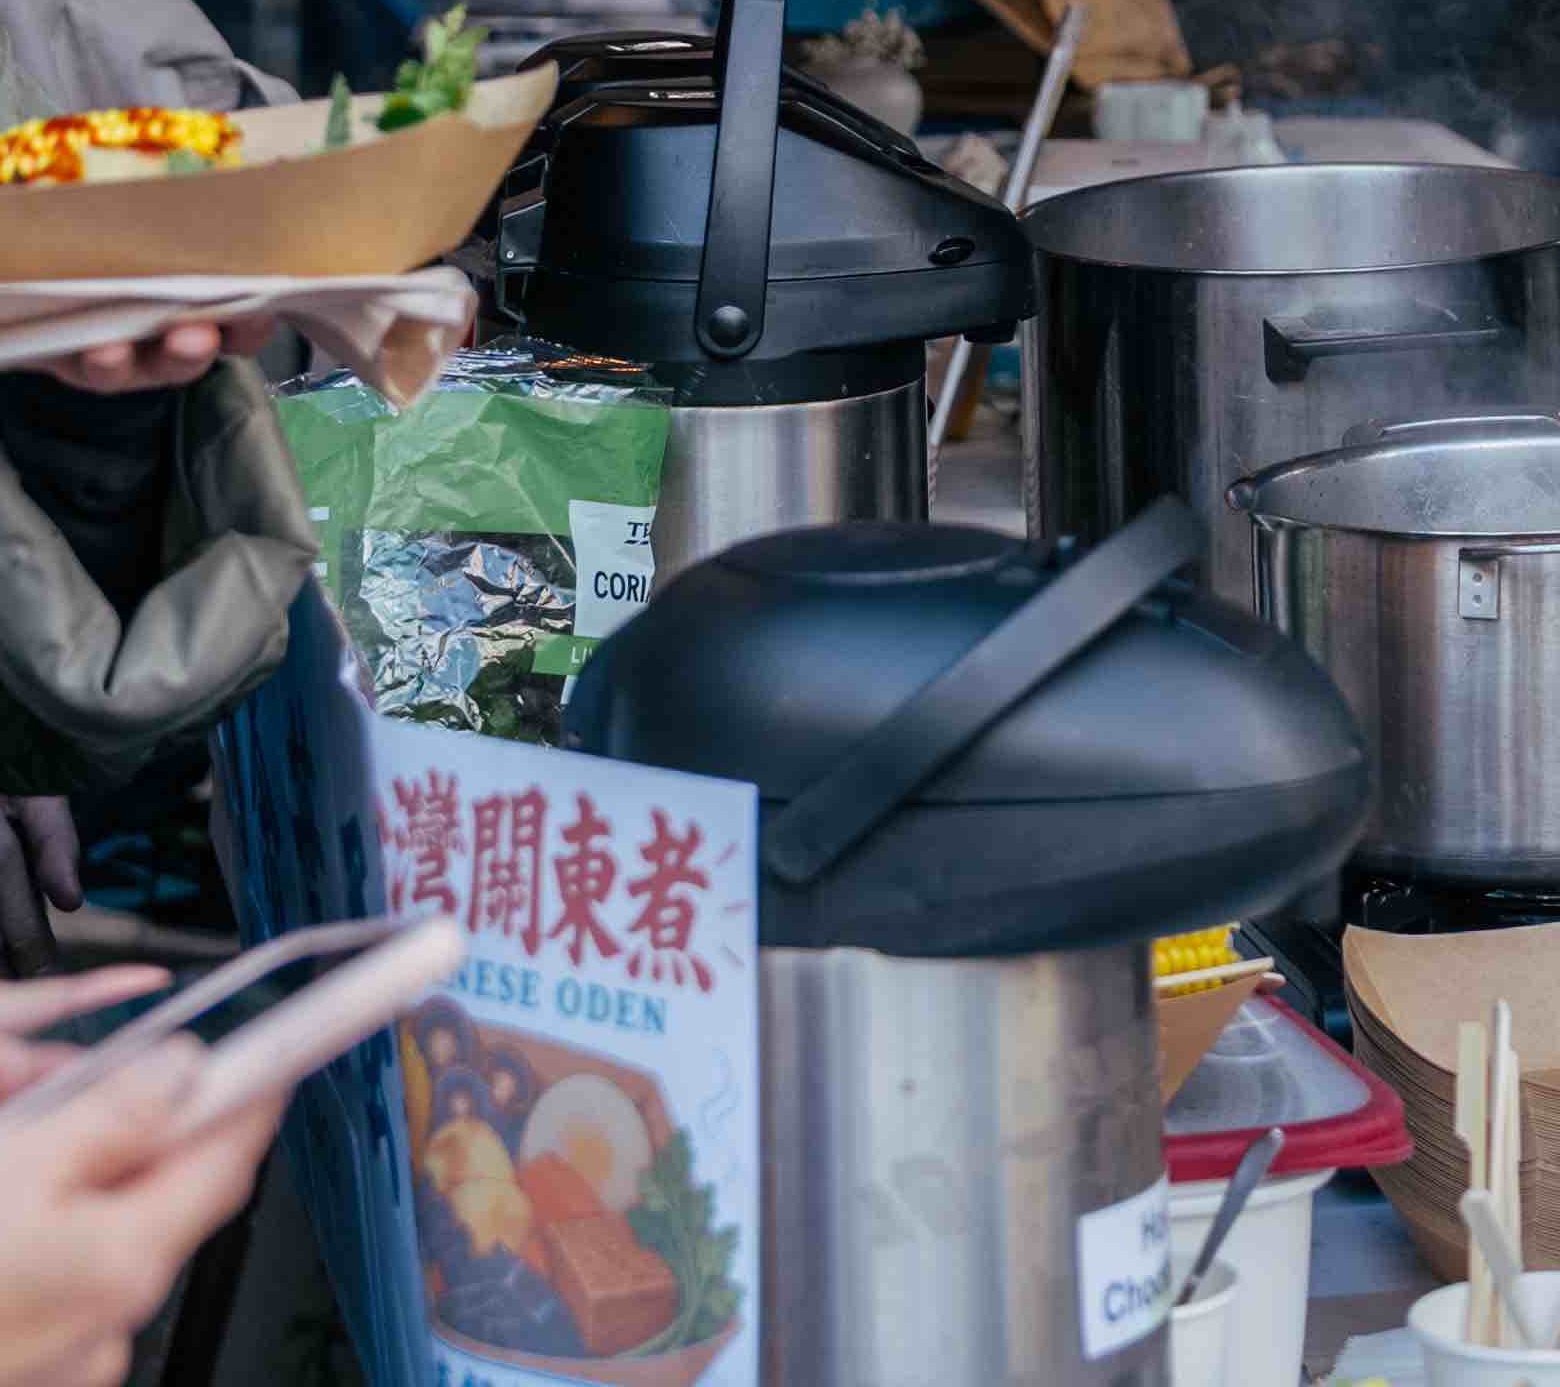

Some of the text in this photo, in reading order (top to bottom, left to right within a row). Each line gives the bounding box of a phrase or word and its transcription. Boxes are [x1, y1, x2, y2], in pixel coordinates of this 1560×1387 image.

[593, 569, 650, 604] CORI
[376, 766, 714, 995] 灣關東煮
[555, 976, 667, 1035] ODEN
